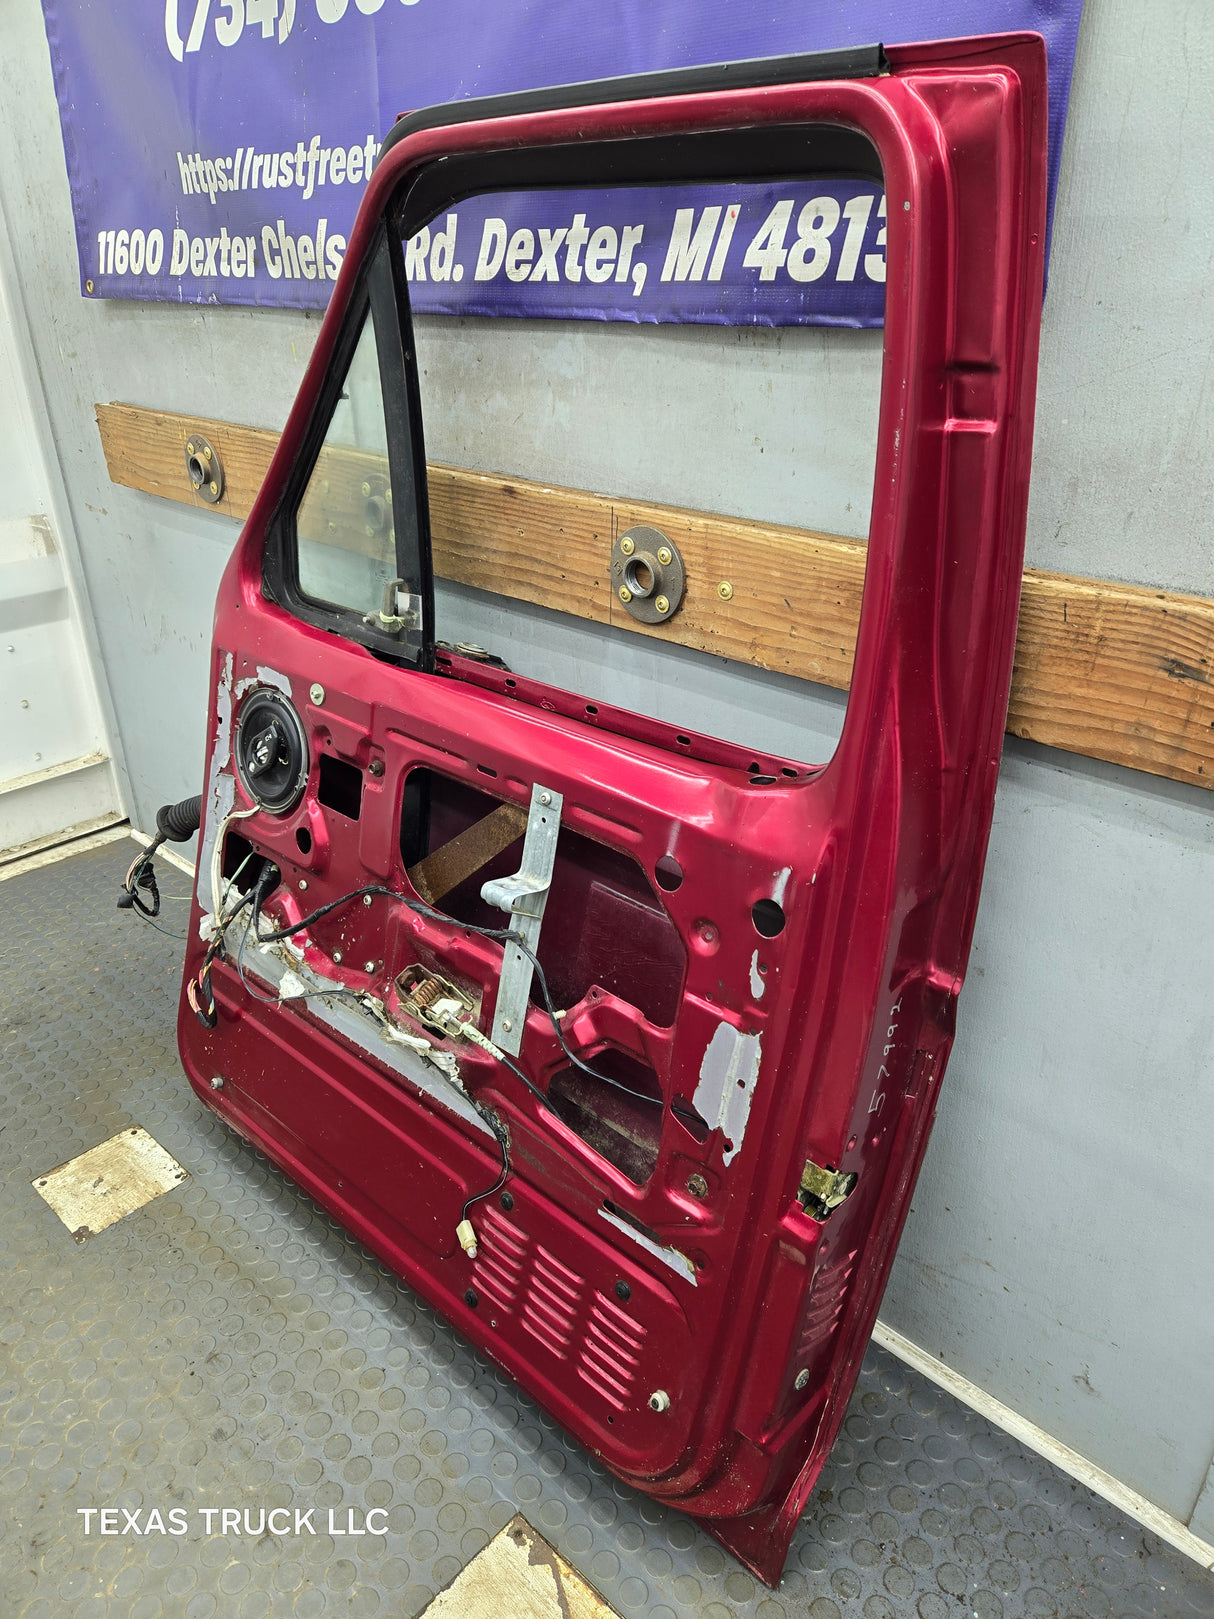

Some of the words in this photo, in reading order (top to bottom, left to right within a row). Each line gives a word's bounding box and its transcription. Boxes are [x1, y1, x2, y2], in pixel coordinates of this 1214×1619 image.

[176, 134, 382, 204] https://rustfreet
[97, 228, 163, 276] 11600
[169, 228, 256, 279] Dexter
[405, 213, 464, 283] Rd.
[474, 213, 647, 296] Dexter,
[661, 204, 743, 282] MI
[867, 996, 903, 1118] 57992
